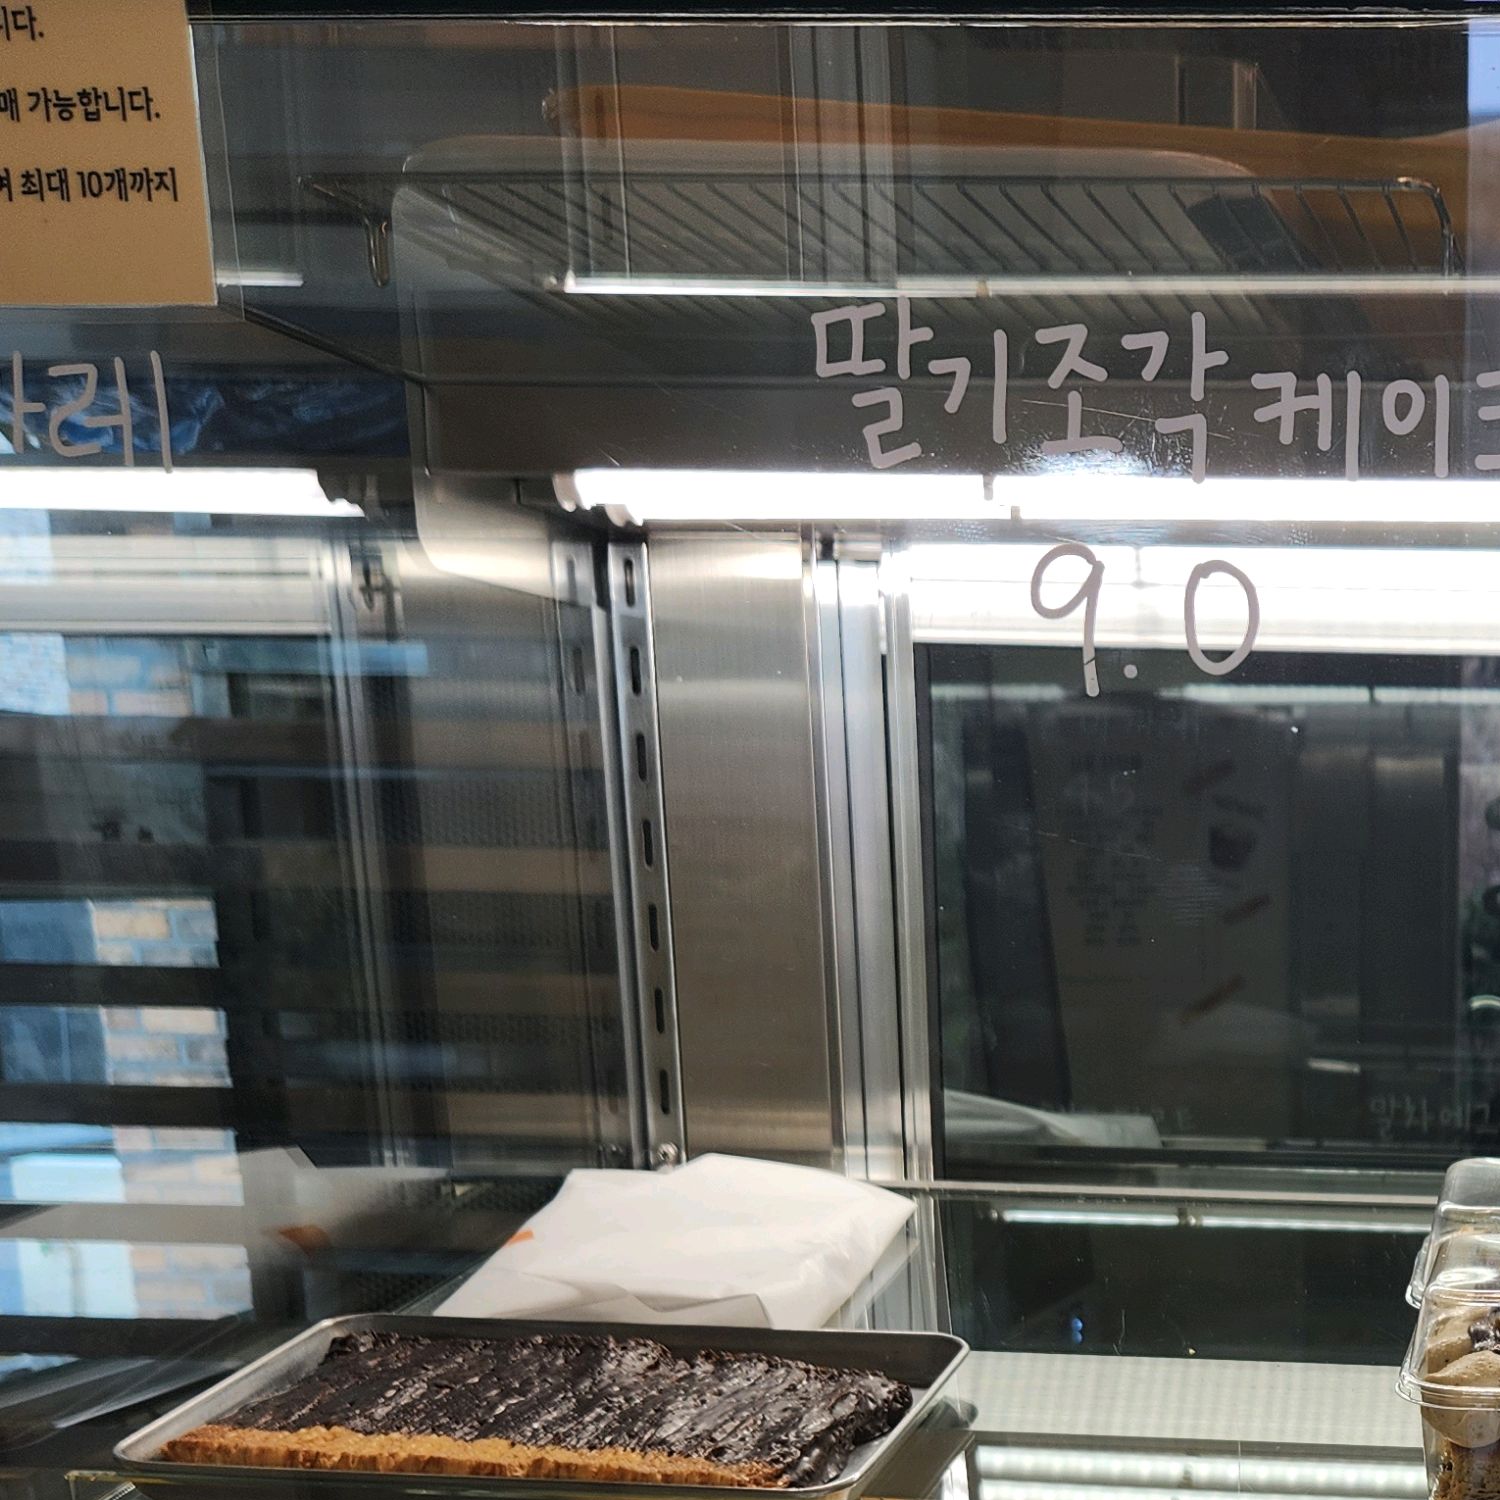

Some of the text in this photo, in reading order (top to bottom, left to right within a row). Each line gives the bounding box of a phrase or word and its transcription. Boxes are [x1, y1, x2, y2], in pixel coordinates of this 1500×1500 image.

[27, 87, 161, 122] 가능합니다.
[21, 168, 71, 202] 최대
[76, 167, 178, 202] 10개까지
[1031, 544, 1259, 697] 9.0
